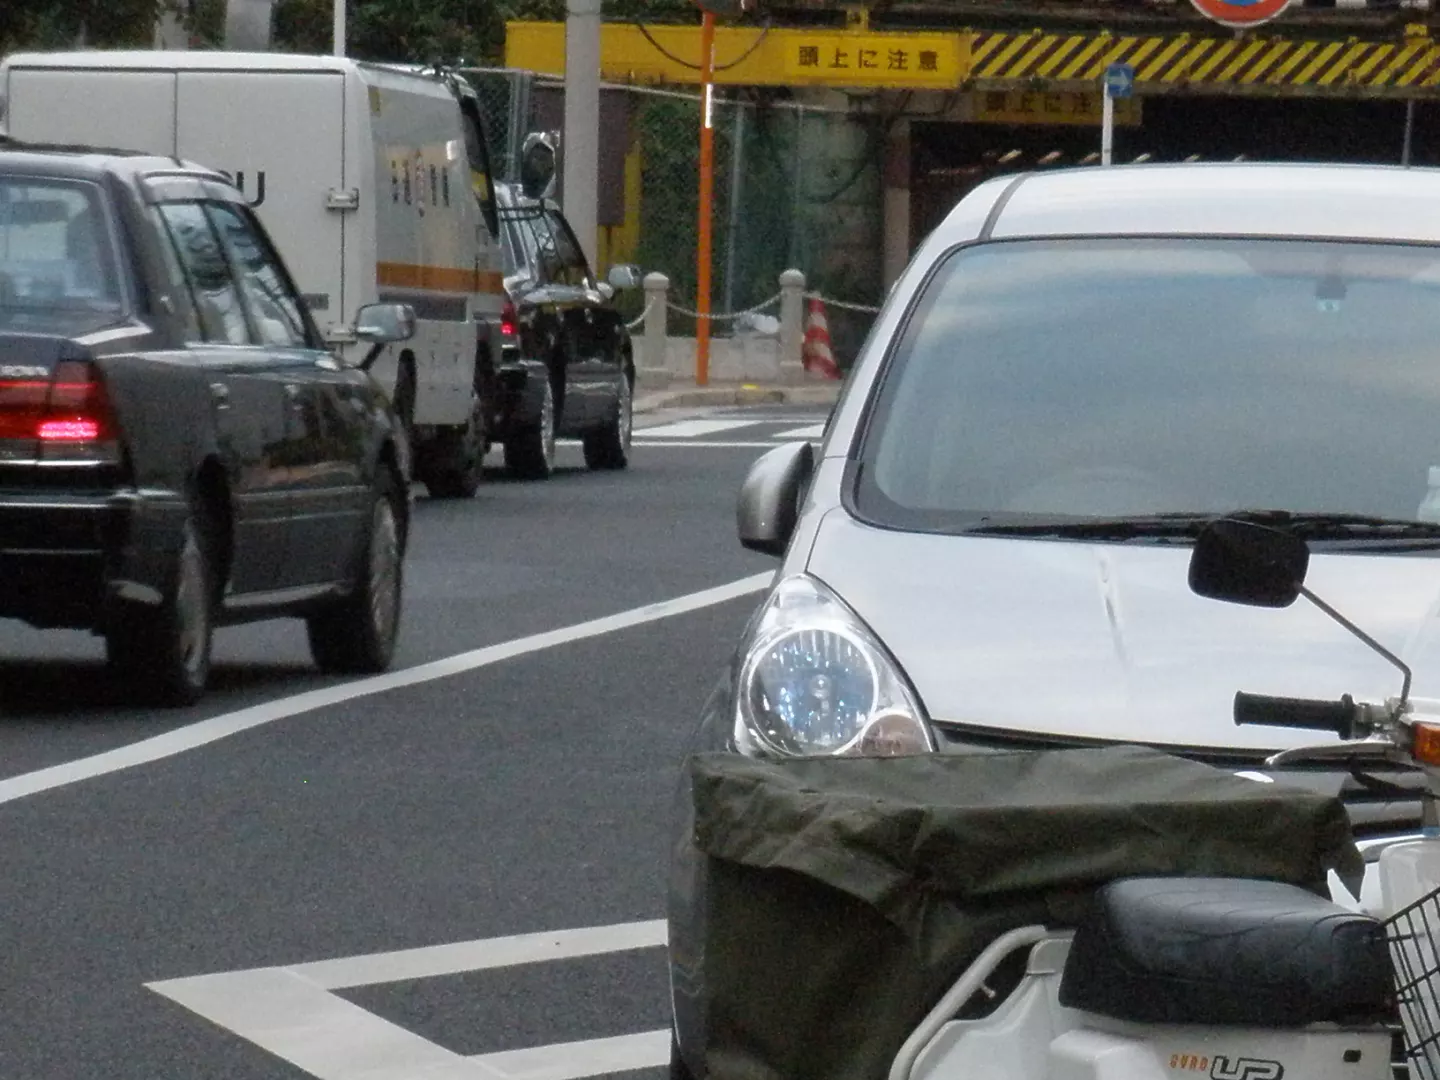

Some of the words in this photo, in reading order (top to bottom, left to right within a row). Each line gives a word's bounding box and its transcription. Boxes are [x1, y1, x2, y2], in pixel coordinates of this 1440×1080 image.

[798, 45, 938, 72] 頭上に注意
